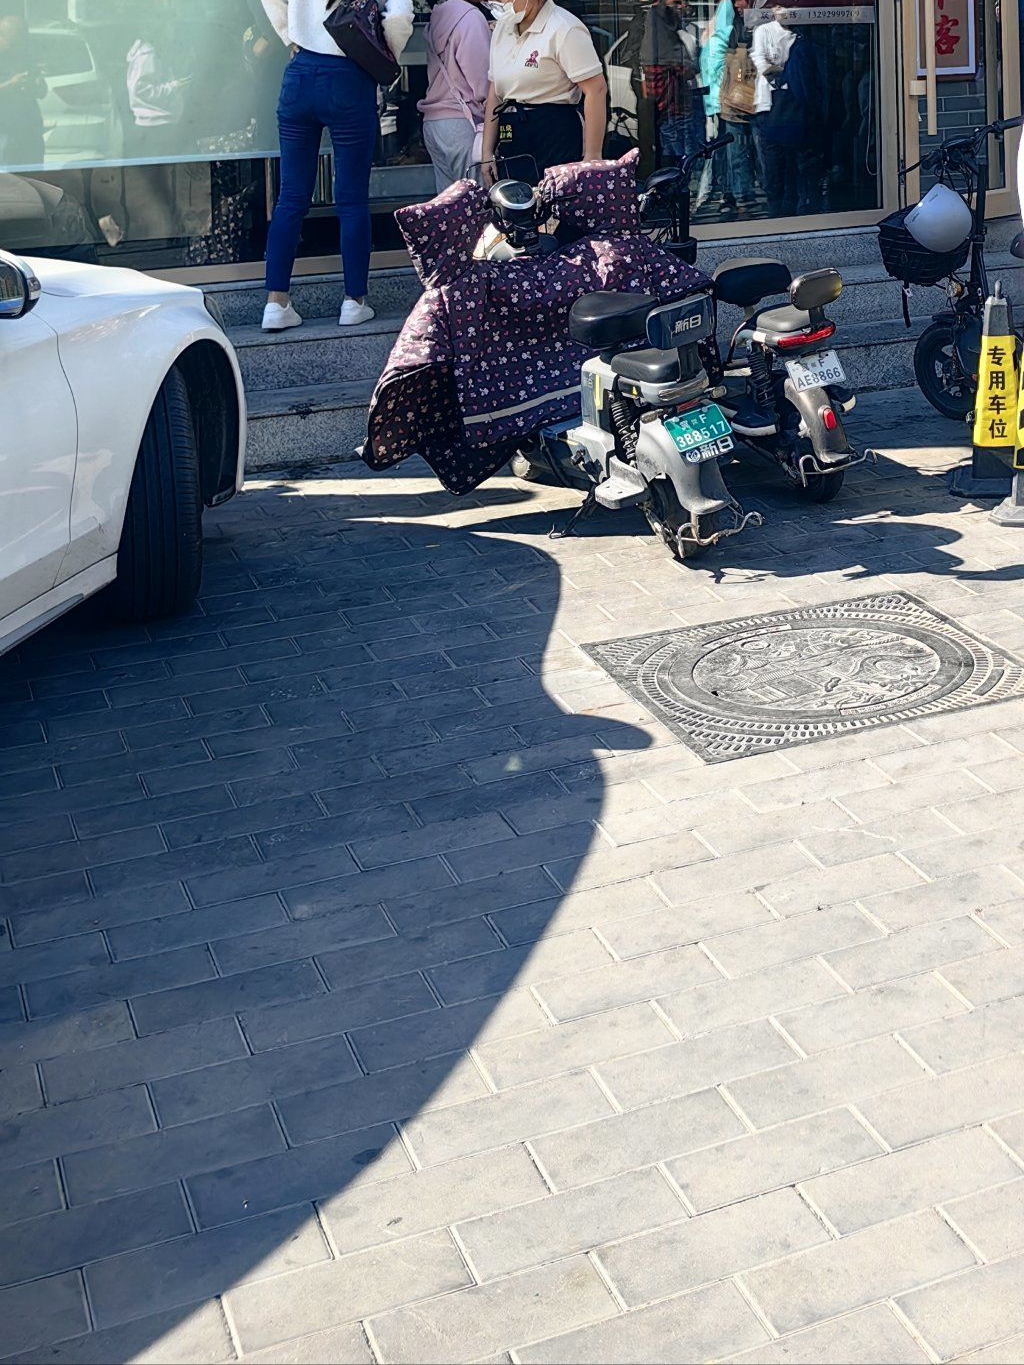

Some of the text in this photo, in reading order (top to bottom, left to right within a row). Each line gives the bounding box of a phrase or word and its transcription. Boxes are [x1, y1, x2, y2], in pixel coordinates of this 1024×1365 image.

[674, 314, 701, 334] 新日
[797, 367, 841, 388] AE8866
[987, 345, 1008, 439] 专用车位
[676, 420, 726, 447] 3B8517
[699, 435, 734, 459] 新日
